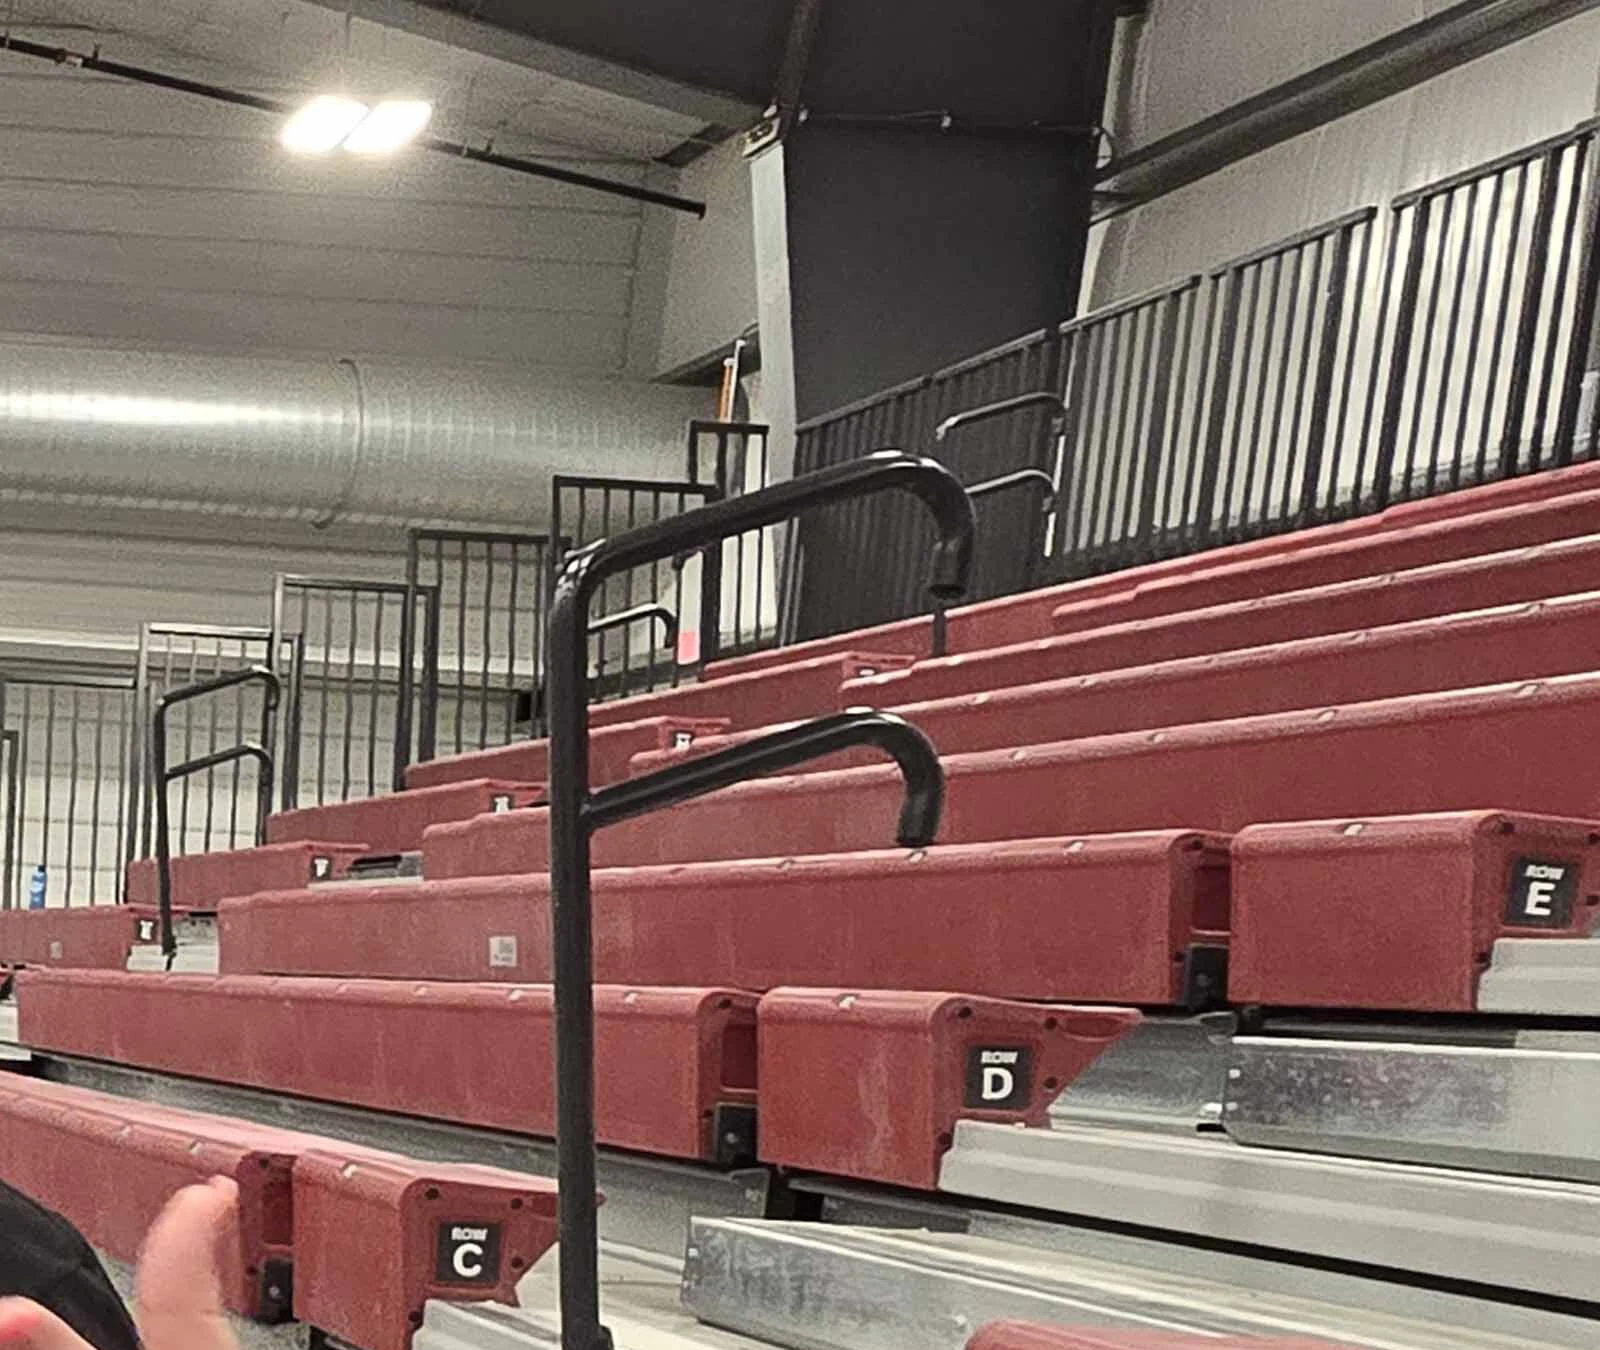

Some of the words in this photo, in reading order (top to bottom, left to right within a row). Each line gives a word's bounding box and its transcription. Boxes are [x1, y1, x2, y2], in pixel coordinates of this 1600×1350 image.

[1524, 864, 1565, 880] ROW
[1524, 881, 1556, 916] E
[981, 1051, 1018, 1064] ROW
[981, 1066, 1014, 1100] D
[451, 1226, 489, 1241] ROW
[453, 1242, 484, 1278] C
